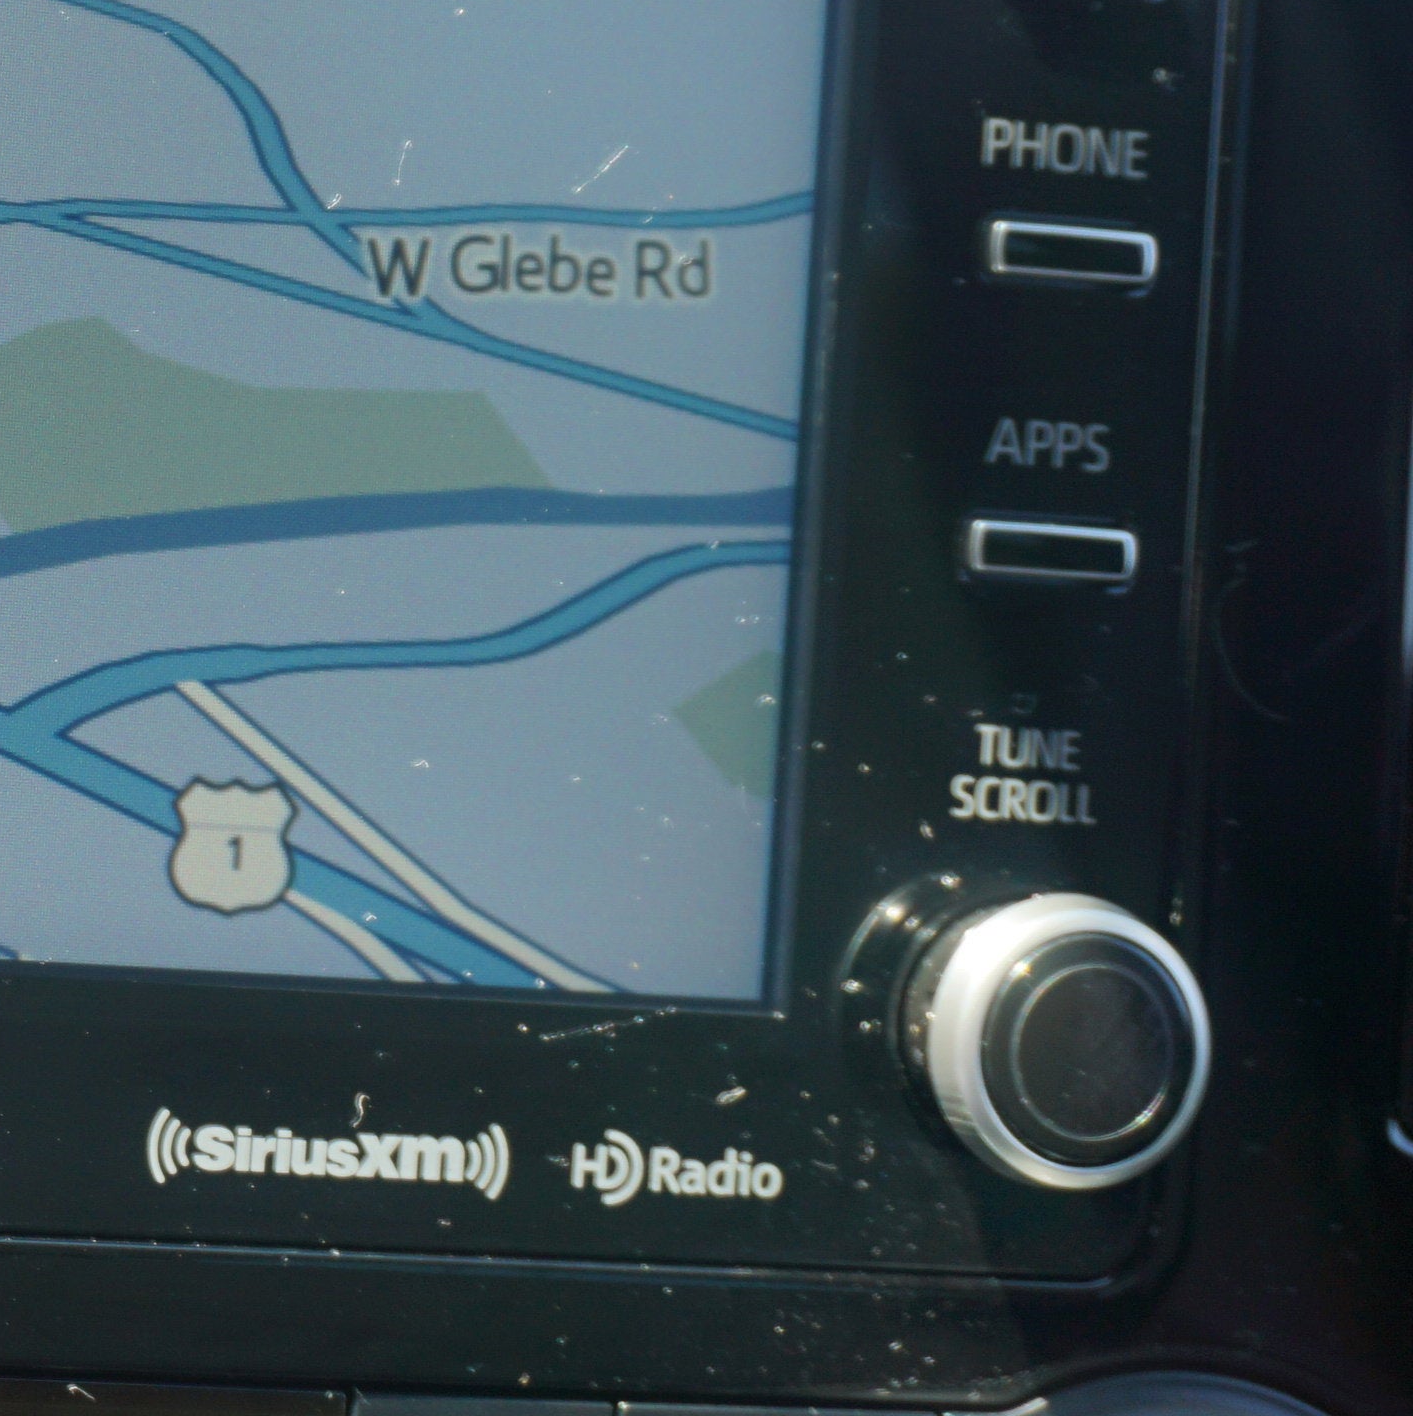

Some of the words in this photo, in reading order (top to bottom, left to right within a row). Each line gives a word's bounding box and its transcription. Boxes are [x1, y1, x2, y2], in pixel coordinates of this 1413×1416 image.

[981, 116, 1150, 180] PHONE
[367, 236, 429, 297] W
[450, 232, 616, 297] Glebe
[634, 237, 712, 299] Rd
[984, 417, 1110, 473] APPS
[974, 724, 1082, 771] TUNE
[948, 775, 1096, 825] SCROLL
[227, 836, 243, 871] 1
[647, 1147, 783, 1199] Radio
